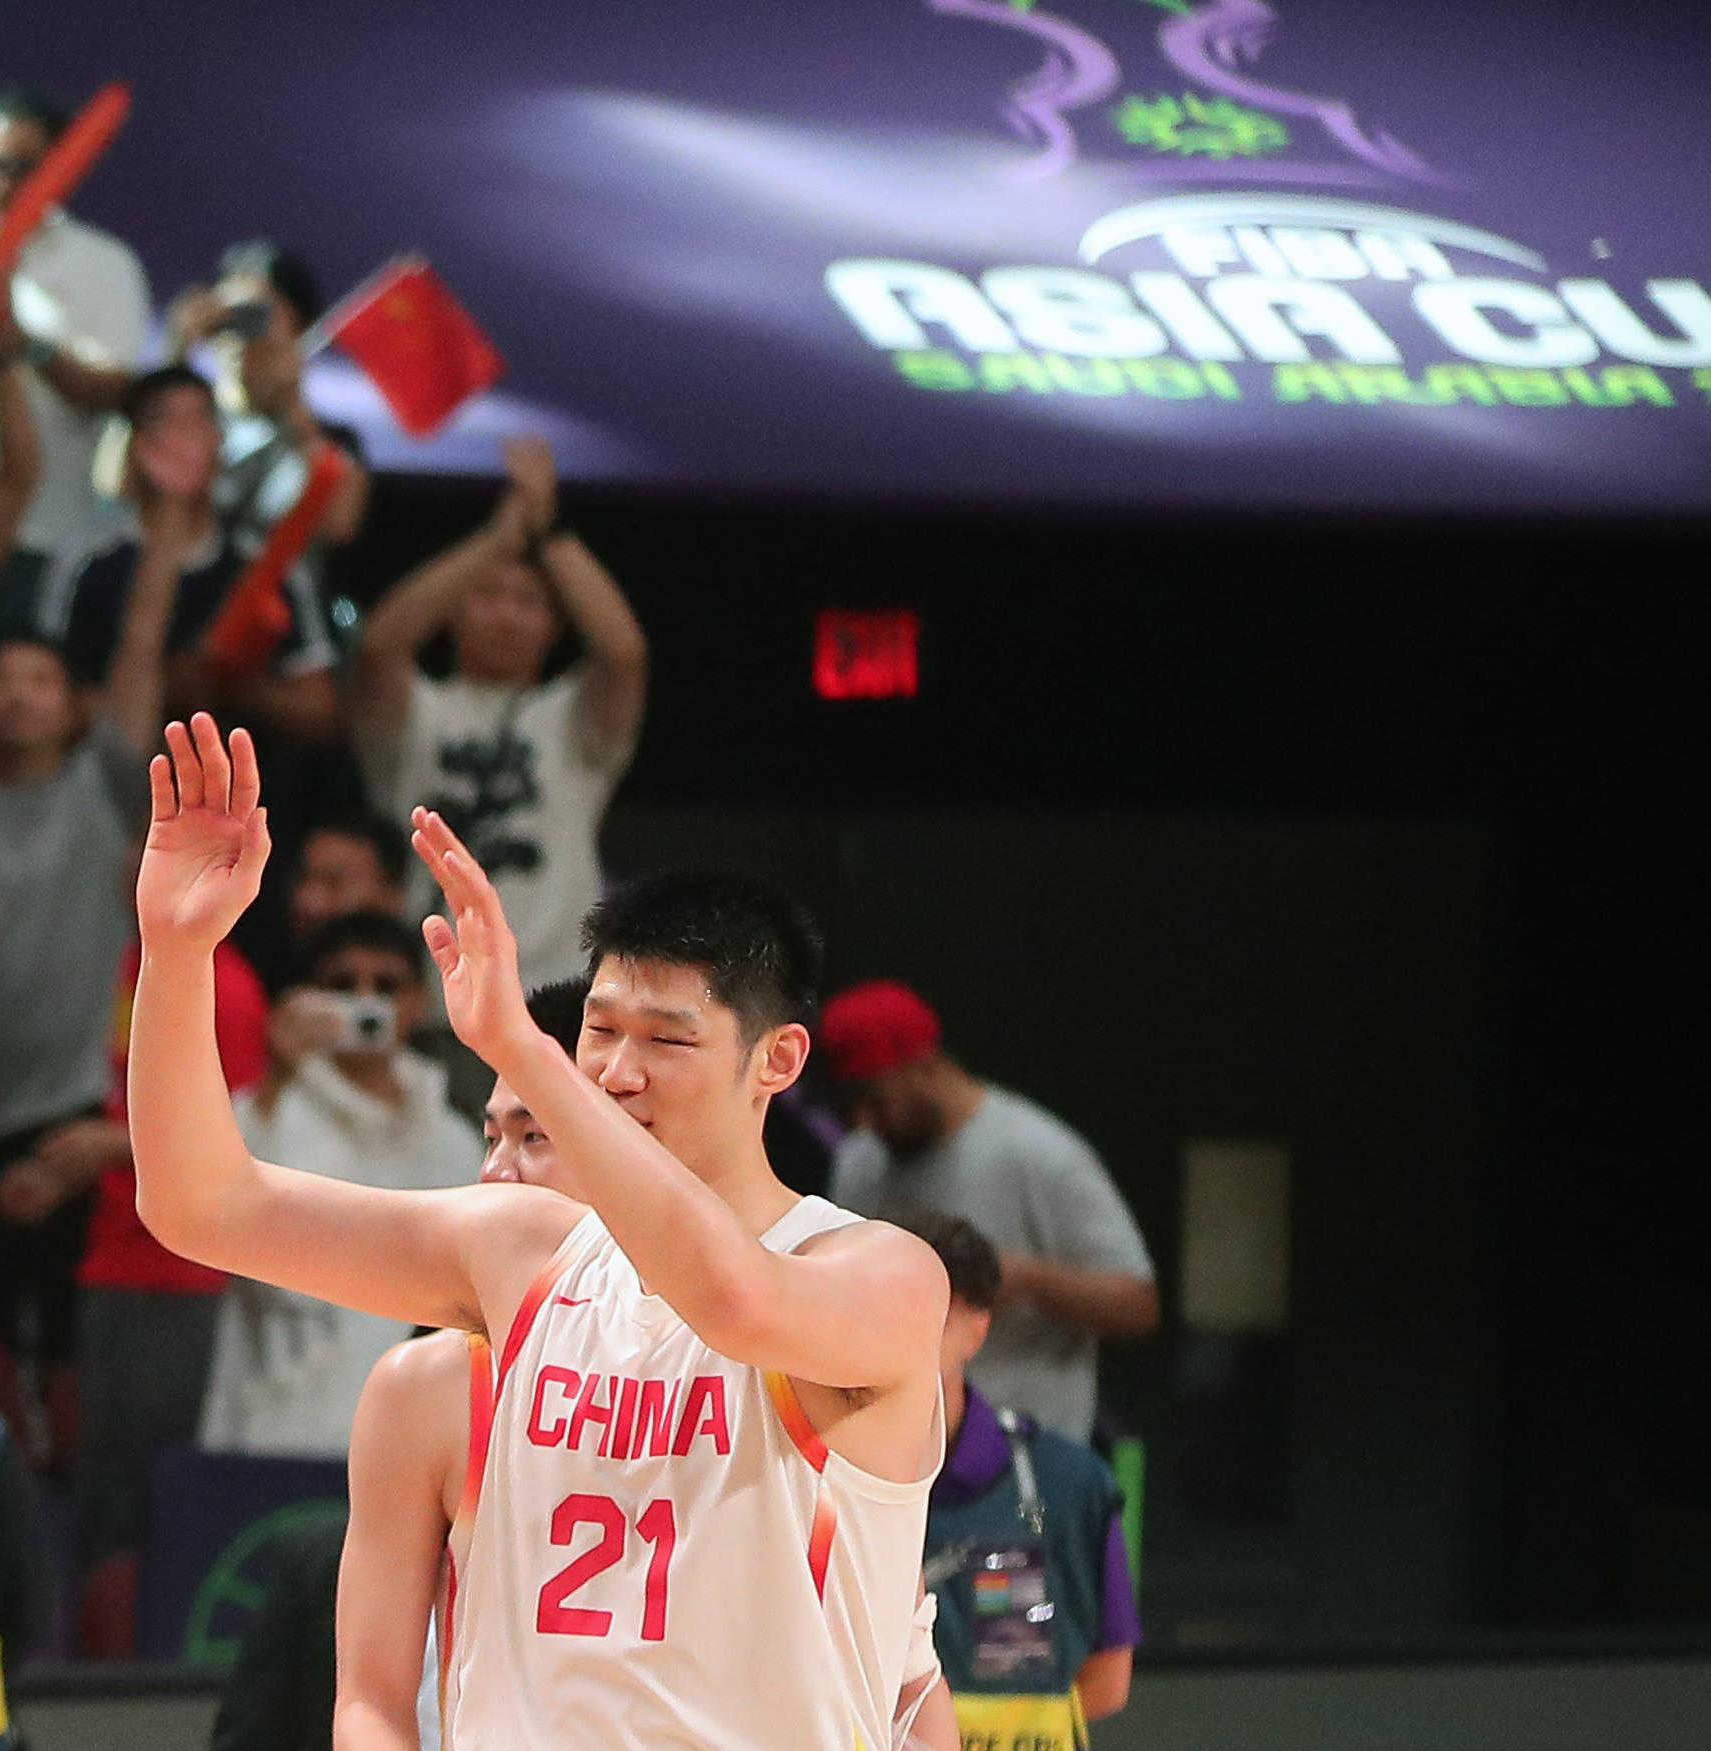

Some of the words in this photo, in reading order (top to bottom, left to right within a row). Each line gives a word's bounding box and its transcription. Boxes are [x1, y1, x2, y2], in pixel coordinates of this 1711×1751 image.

[1160, 224, 1451, 281] FIBA
[824, 258, 1402, 364] ASIA
[893, 349, 1242, 401] SAUDI
[1274, 362, 1678, 407] ARABIA
[527, 1364, 732, 1461] CHINA
[536, 1494, 676, 1642] 21
